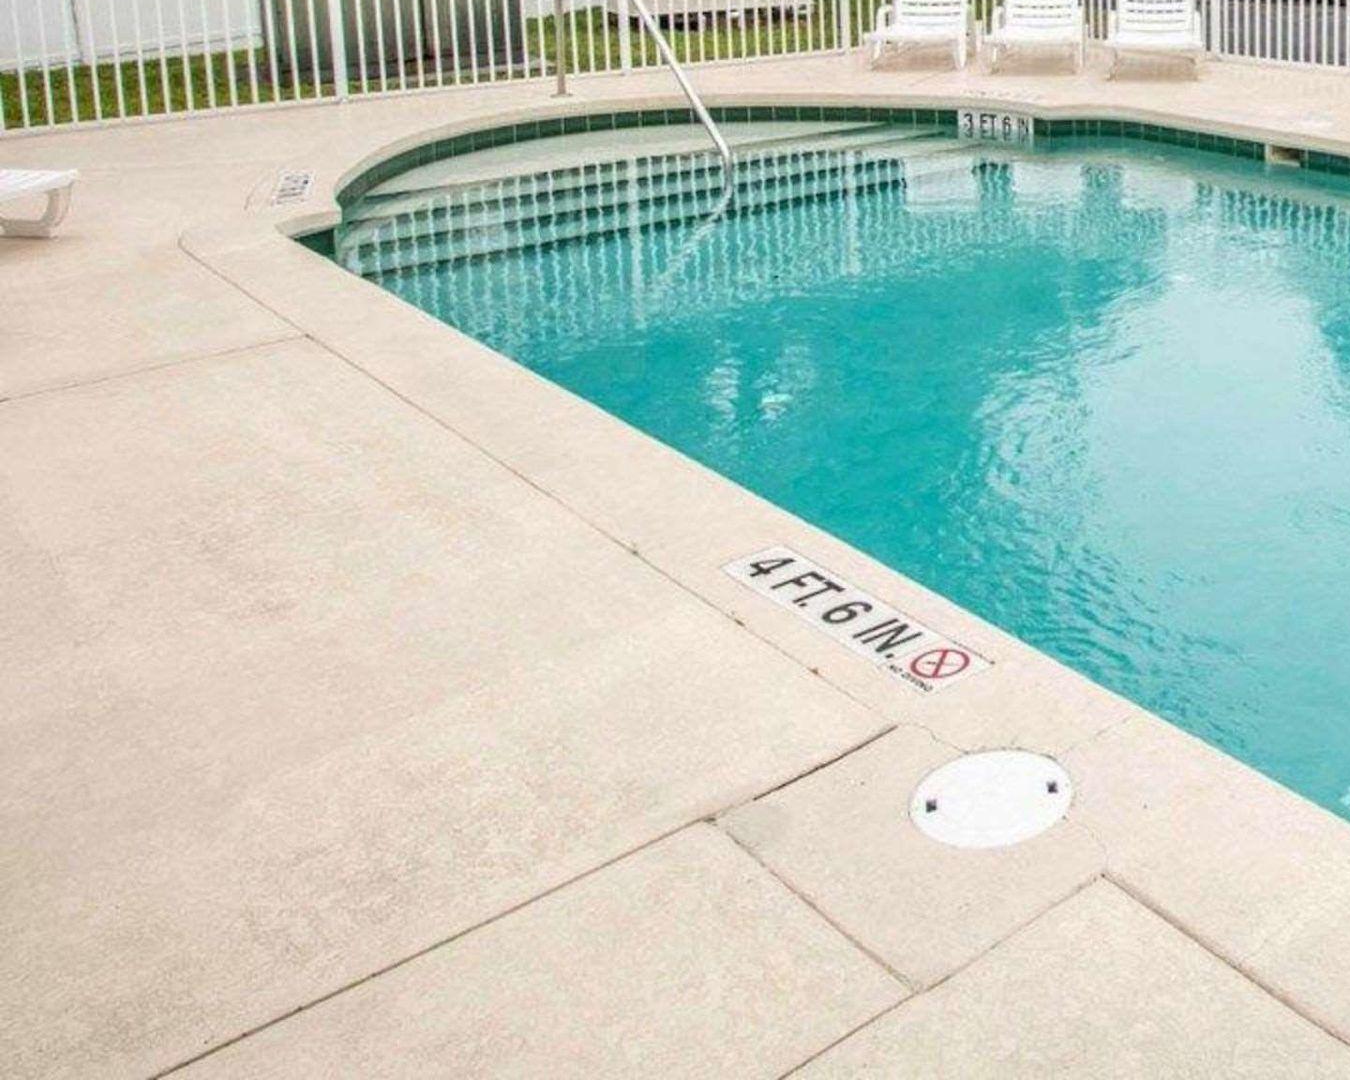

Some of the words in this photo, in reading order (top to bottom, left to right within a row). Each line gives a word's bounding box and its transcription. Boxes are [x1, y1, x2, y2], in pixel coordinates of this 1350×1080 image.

[750, 557, 795, 577] 4
[770, 571, 845, 607] FT.
[821, 601, 873, 624] 6
[852, 618, 922, 658] IN.
